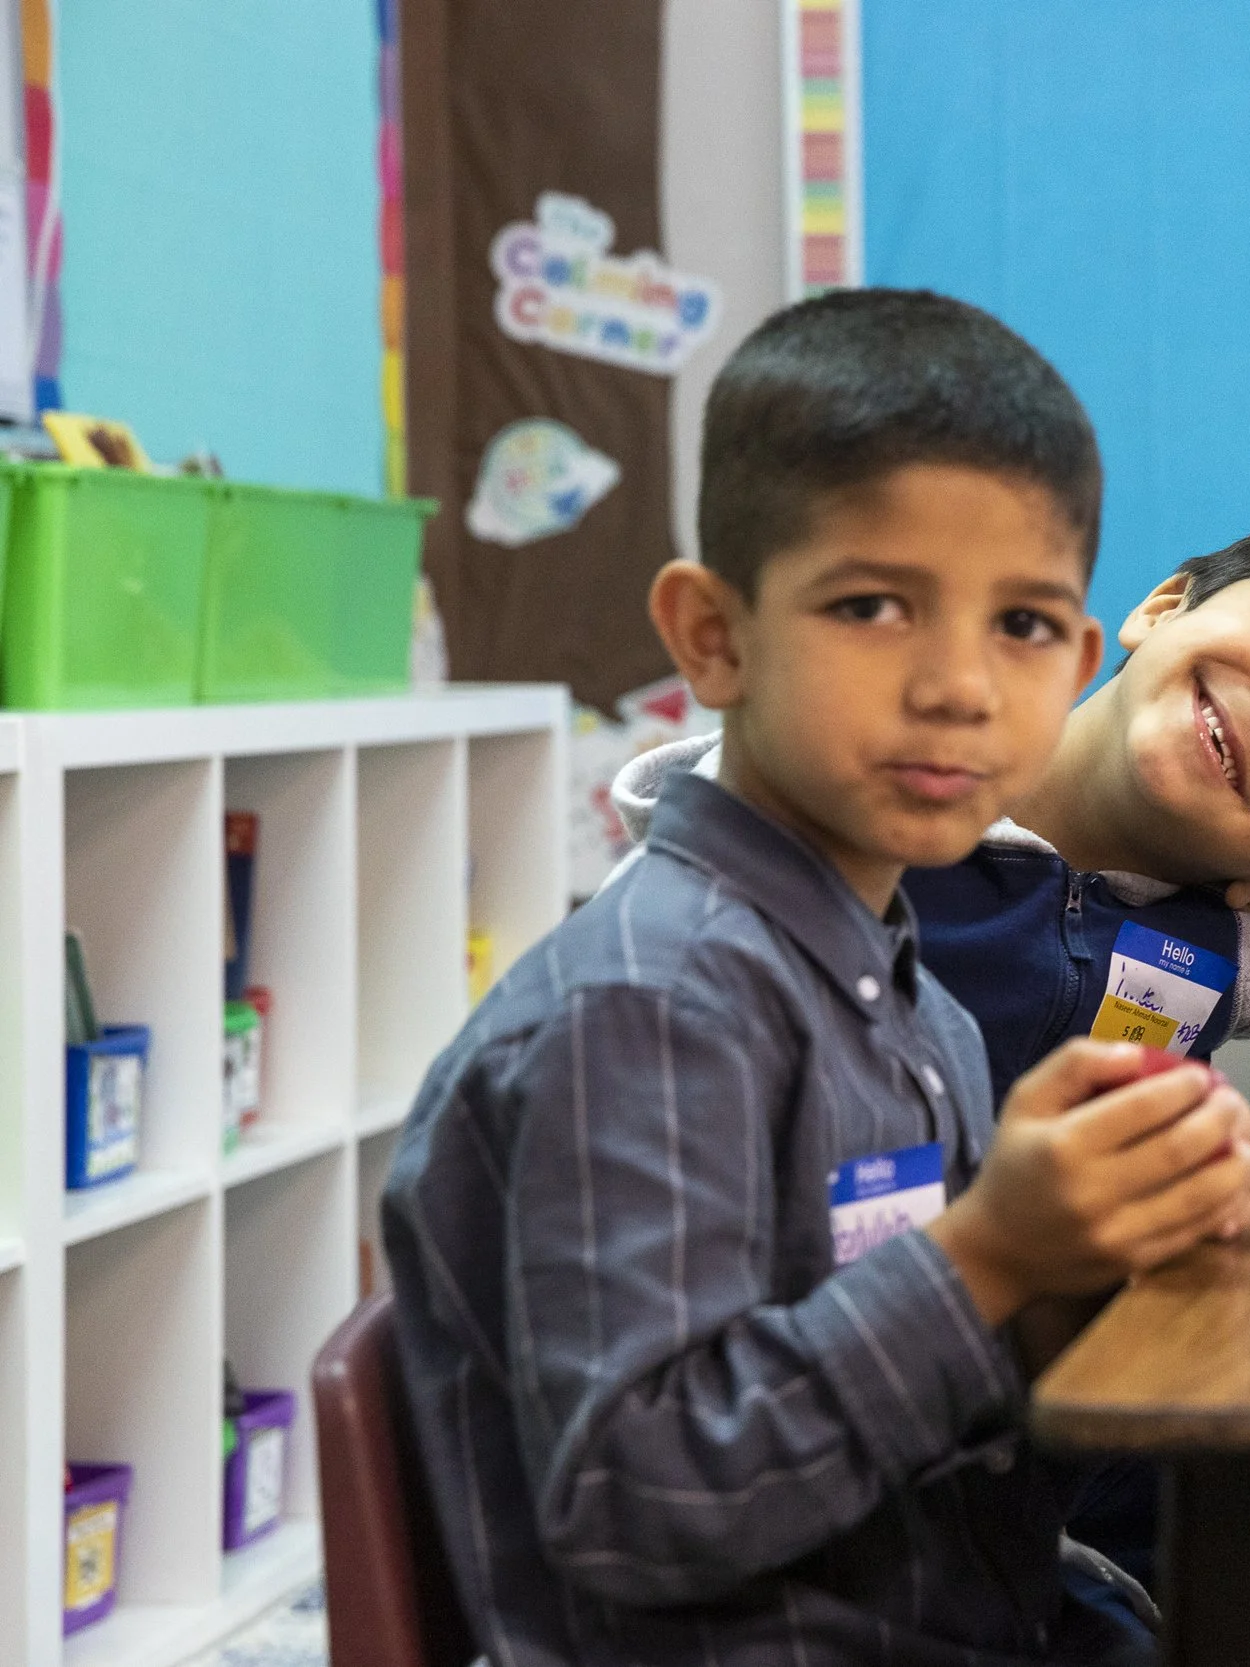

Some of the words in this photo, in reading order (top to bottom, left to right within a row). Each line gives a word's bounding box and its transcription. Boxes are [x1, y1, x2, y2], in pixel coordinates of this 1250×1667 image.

[1161, 939, 1195, 966] Hello
[1158, 958, 1170, 970] my
[1169, 962, 1185, 974] name
[1184, 967, 1191, 976] is
